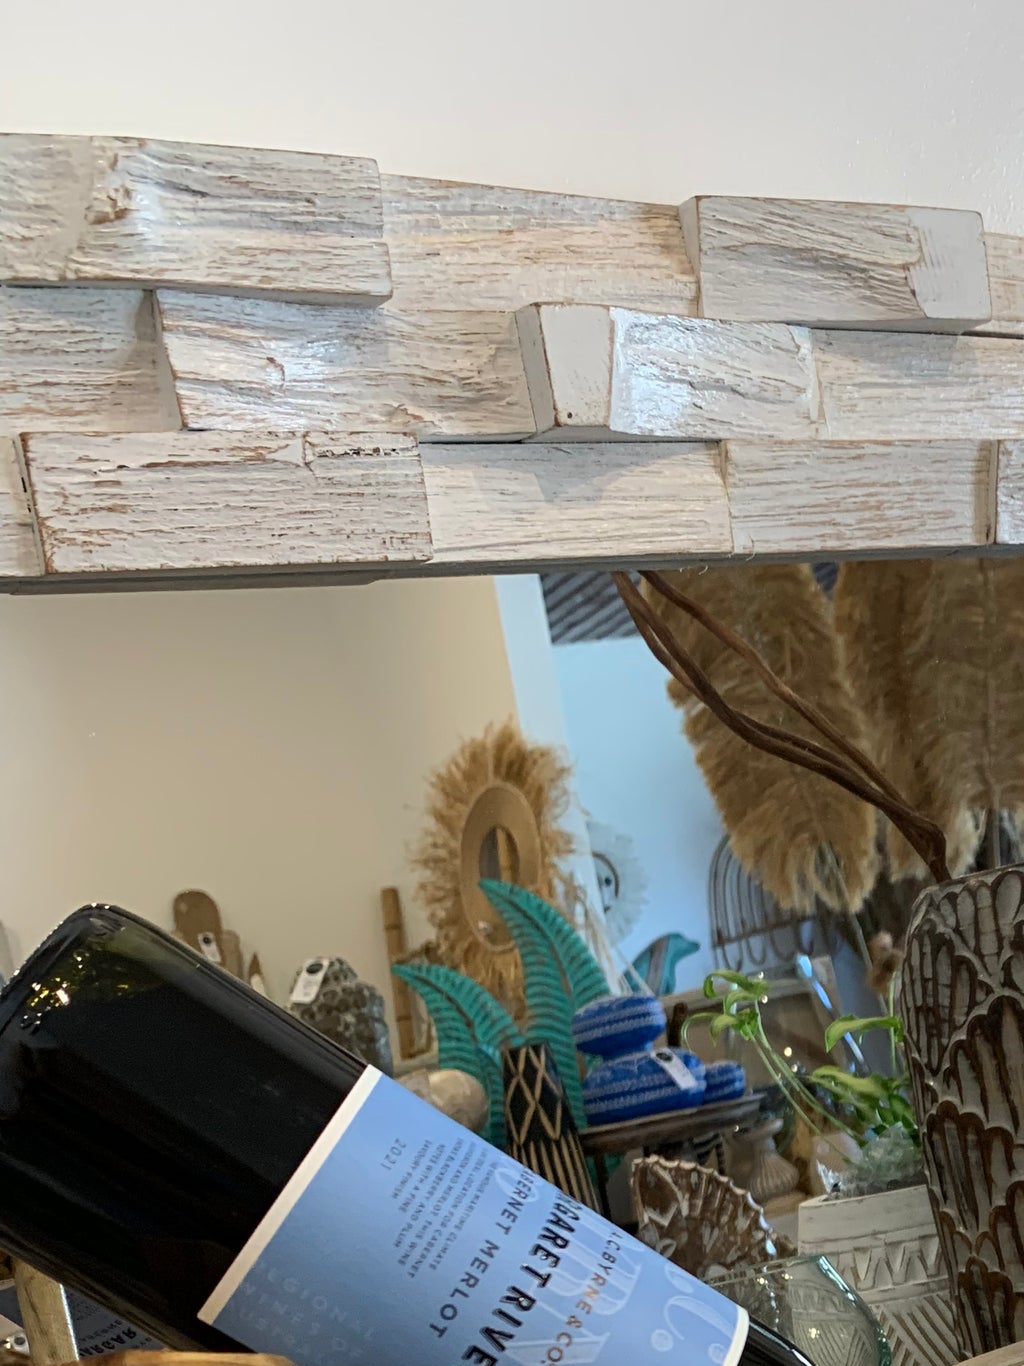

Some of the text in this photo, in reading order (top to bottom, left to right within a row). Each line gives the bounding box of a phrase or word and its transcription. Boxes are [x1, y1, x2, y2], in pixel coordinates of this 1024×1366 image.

[377, 1137, 408, 1172] 2021
[389, 1170, 413, 1200] FINISH
[415, 1163, 434, 1185] WITH
[397, 1191, 417, 1213] FINE
[408, 1200, 427, 1222] AND
[413, 1218, 433, 1240] THIS
[436, 1209, 455, 1229] FOR
[391, 1221, 415, 1249] PLUM
[395, 1240, 419, 1267] WINE
[405, 1227, 443, 1279] CABERNET
[427, 1230, 459, 1271] CLIMATE
[425, 1236, 500, 1341] MERLOT
[562, 1311, 586, 1333] &
